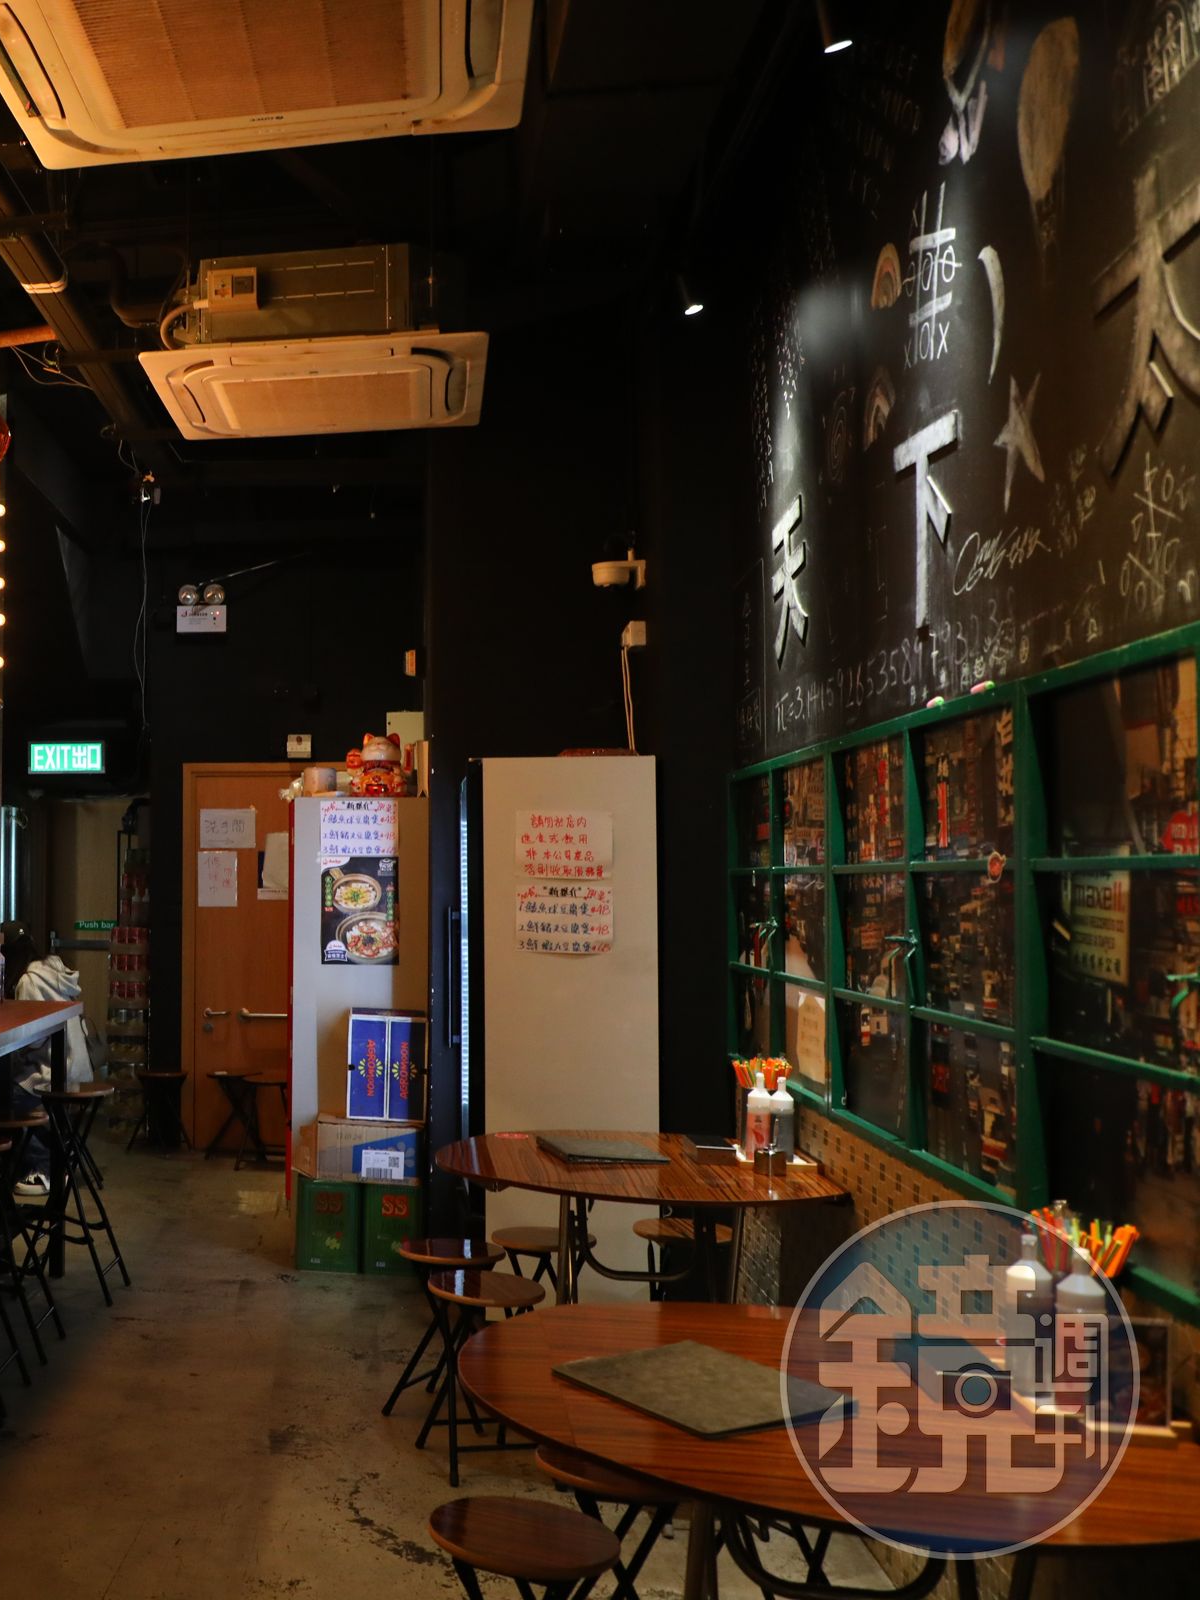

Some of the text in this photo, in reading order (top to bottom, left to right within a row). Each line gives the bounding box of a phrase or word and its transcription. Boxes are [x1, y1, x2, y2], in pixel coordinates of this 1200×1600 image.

[34, 746, 101, 769] EXIT 出口
[1073, 880, 1123, 912] maxell
[79, 920, 115, 929] Push bar
